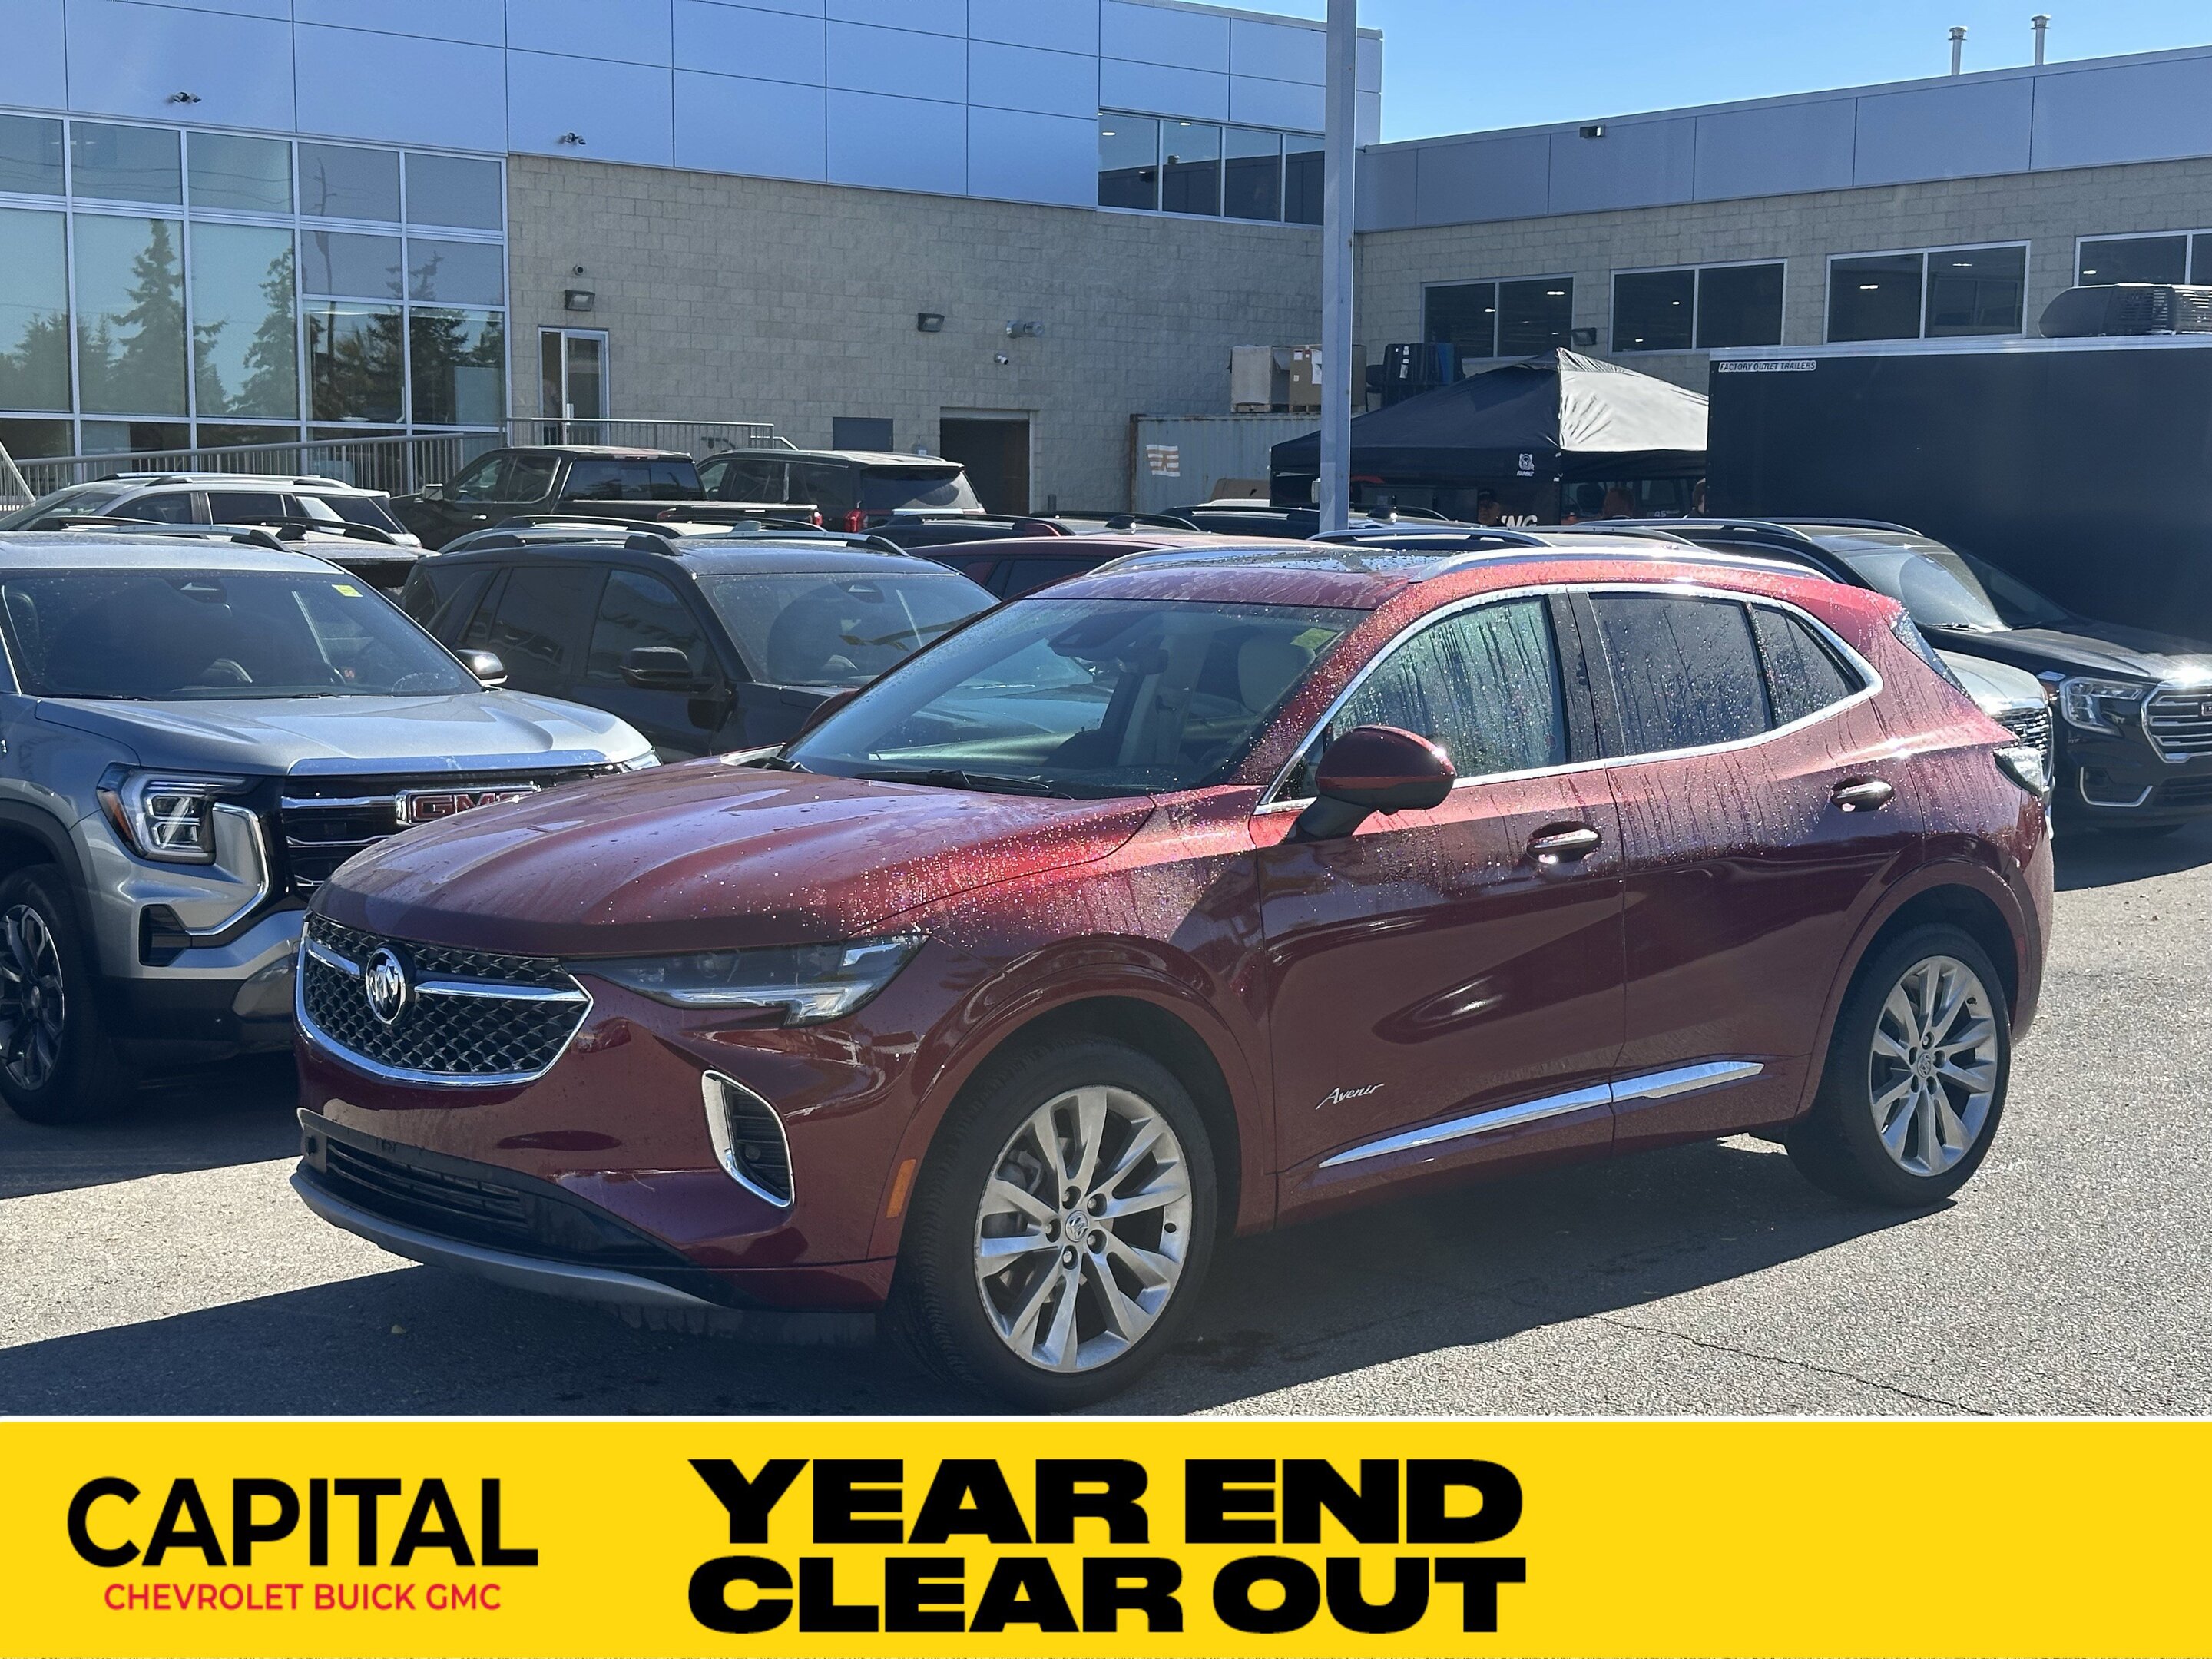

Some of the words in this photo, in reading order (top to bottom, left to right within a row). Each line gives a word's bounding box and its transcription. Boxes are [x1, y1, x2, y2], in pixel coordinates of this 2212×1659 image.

[1720, 363, 1753, 371] FACTORY
[412, 792, 533, 820] GM
[1315, 1083, 1385, 1111] Avenir
